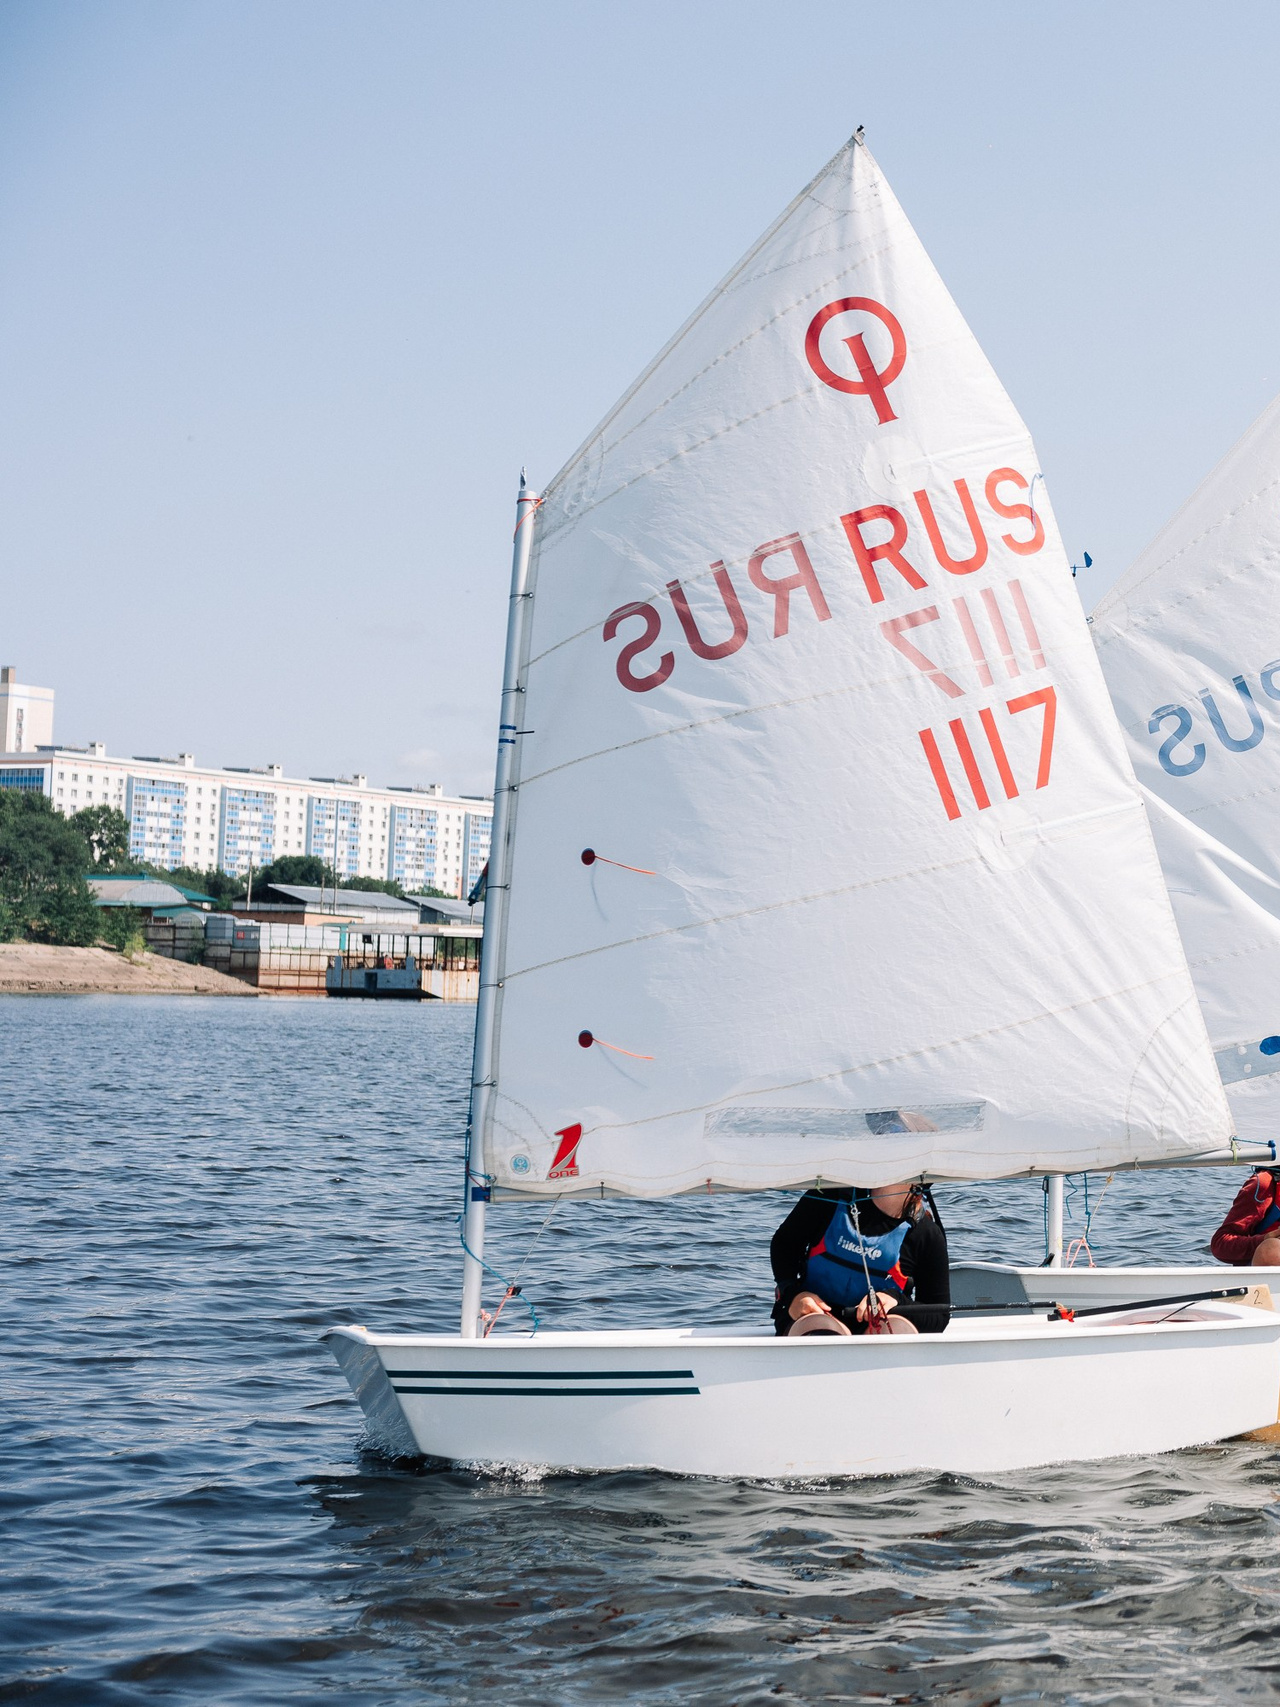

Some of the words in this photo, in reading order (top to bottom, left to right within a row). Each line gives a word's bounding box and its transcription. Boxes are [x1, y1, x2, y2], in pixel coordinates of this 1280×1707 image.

[839, 467, 1045, 604] RUS
[918, 686, 1057, 820] 1117
[1253, 1289, 1263, 1305] 2
